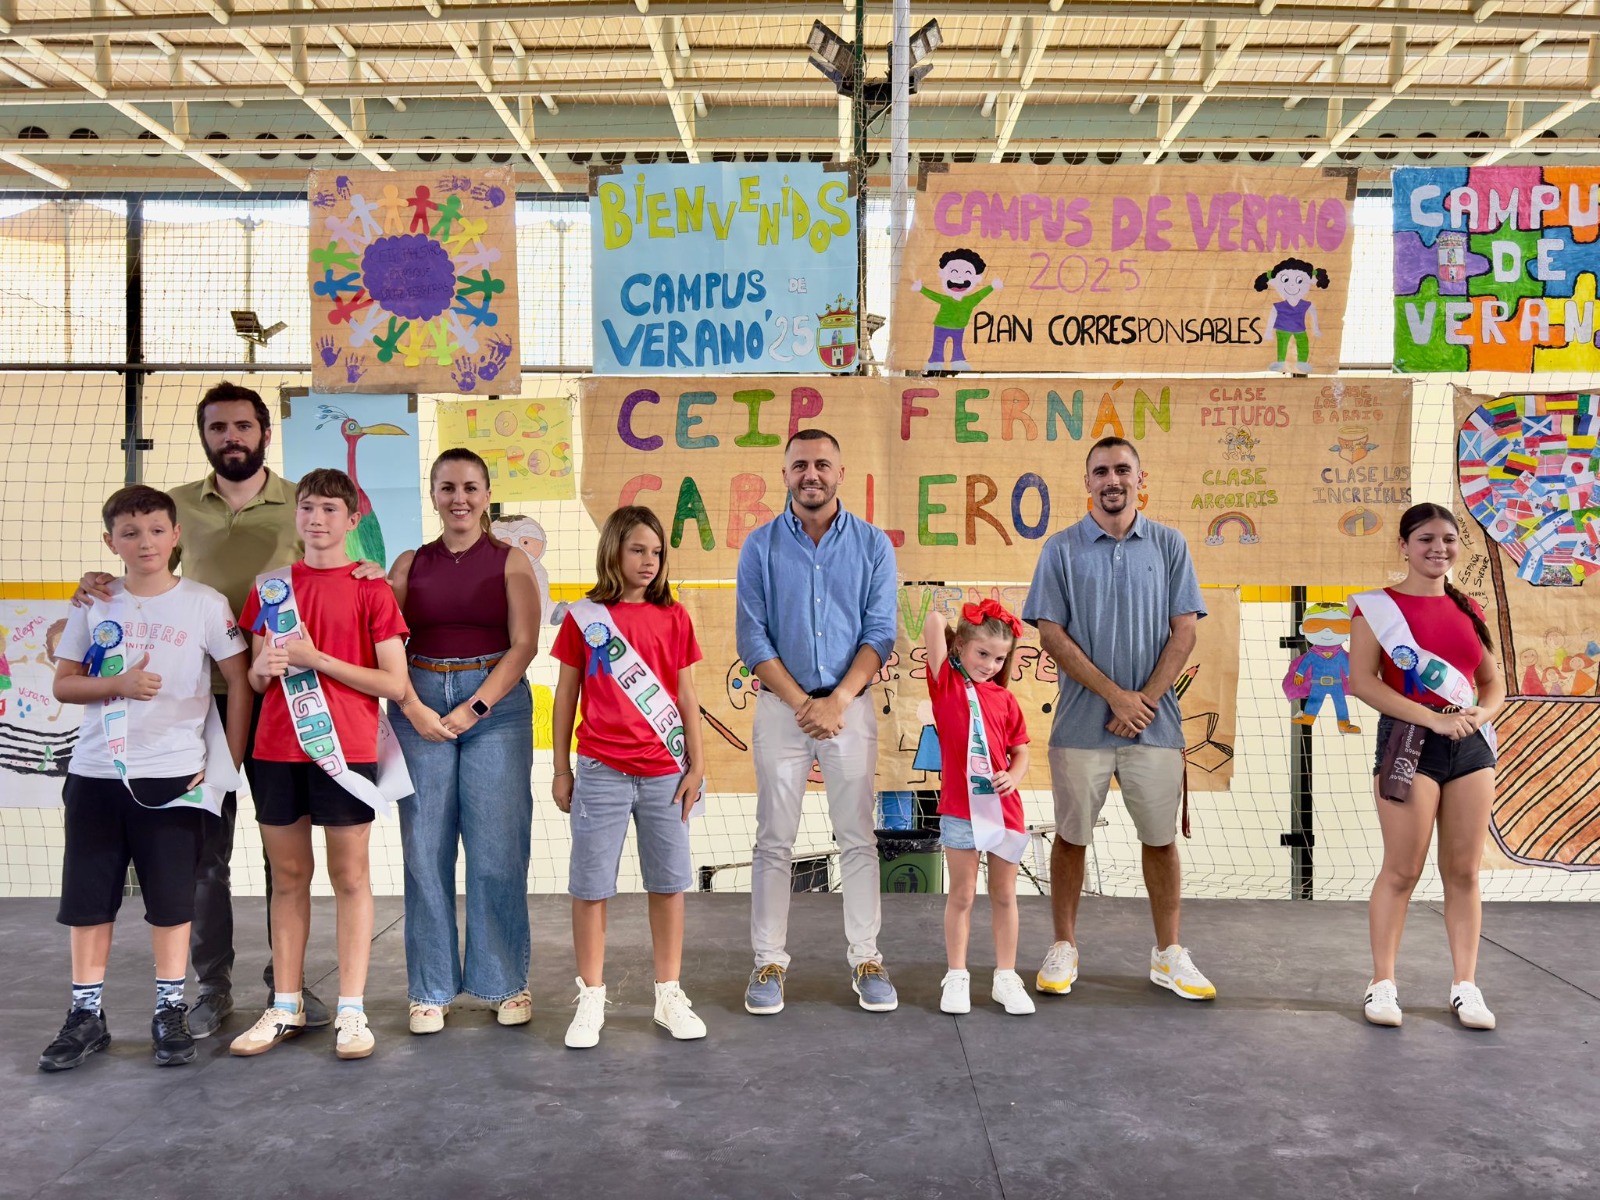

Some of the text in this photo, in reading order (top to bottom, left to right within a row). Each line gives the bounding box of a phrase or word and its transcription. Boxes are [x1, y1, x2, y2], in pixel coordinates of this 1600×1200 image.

[934, 191, 1348, 252] CAMPUS DE VERANO
[1029, 252, 1141, 294] 2025
[1491, 238, 1566, 282] DE
[621, 269, 807, 316] CAMPUS DE
[974, 311, 1264, 346] PLAN CORRESPONSABLES
[1404, 299, 1594, 345] VERAN
[1209, 388, 1267, 402] CLASE
[466, 403, 548, 438] LOS
[617, 380, 1171, 451] CEIP FERNÁN
[1201, 405, 1290, 427] PITUFOS
[1202, 468, 1267, 487] CLASE
[1320, 466, 1379, 483] CLASE
[1191, 489, 1279, 510] ARCOIRIS
[19, 687, 50, 706] verano
